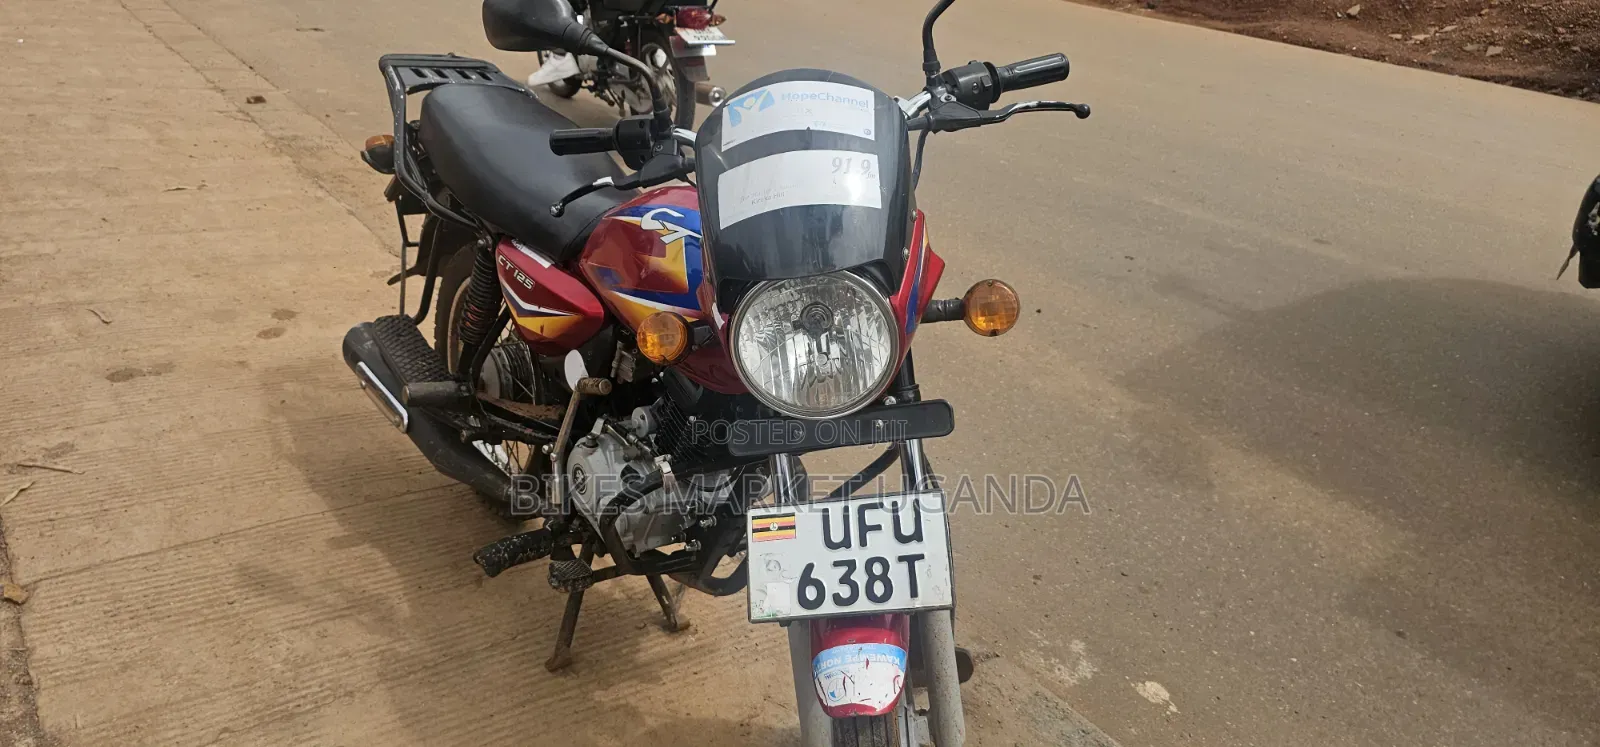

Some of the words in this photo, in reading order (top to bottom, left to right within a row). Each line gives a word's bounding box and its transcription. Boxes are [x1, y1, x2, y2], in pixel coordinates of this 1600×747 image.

[498, 255, 515, 270] CT
[513, 271, 535, 291] 125
[822, 498, 924, 551] UFU
[797, 553, 925, 611] 638T
